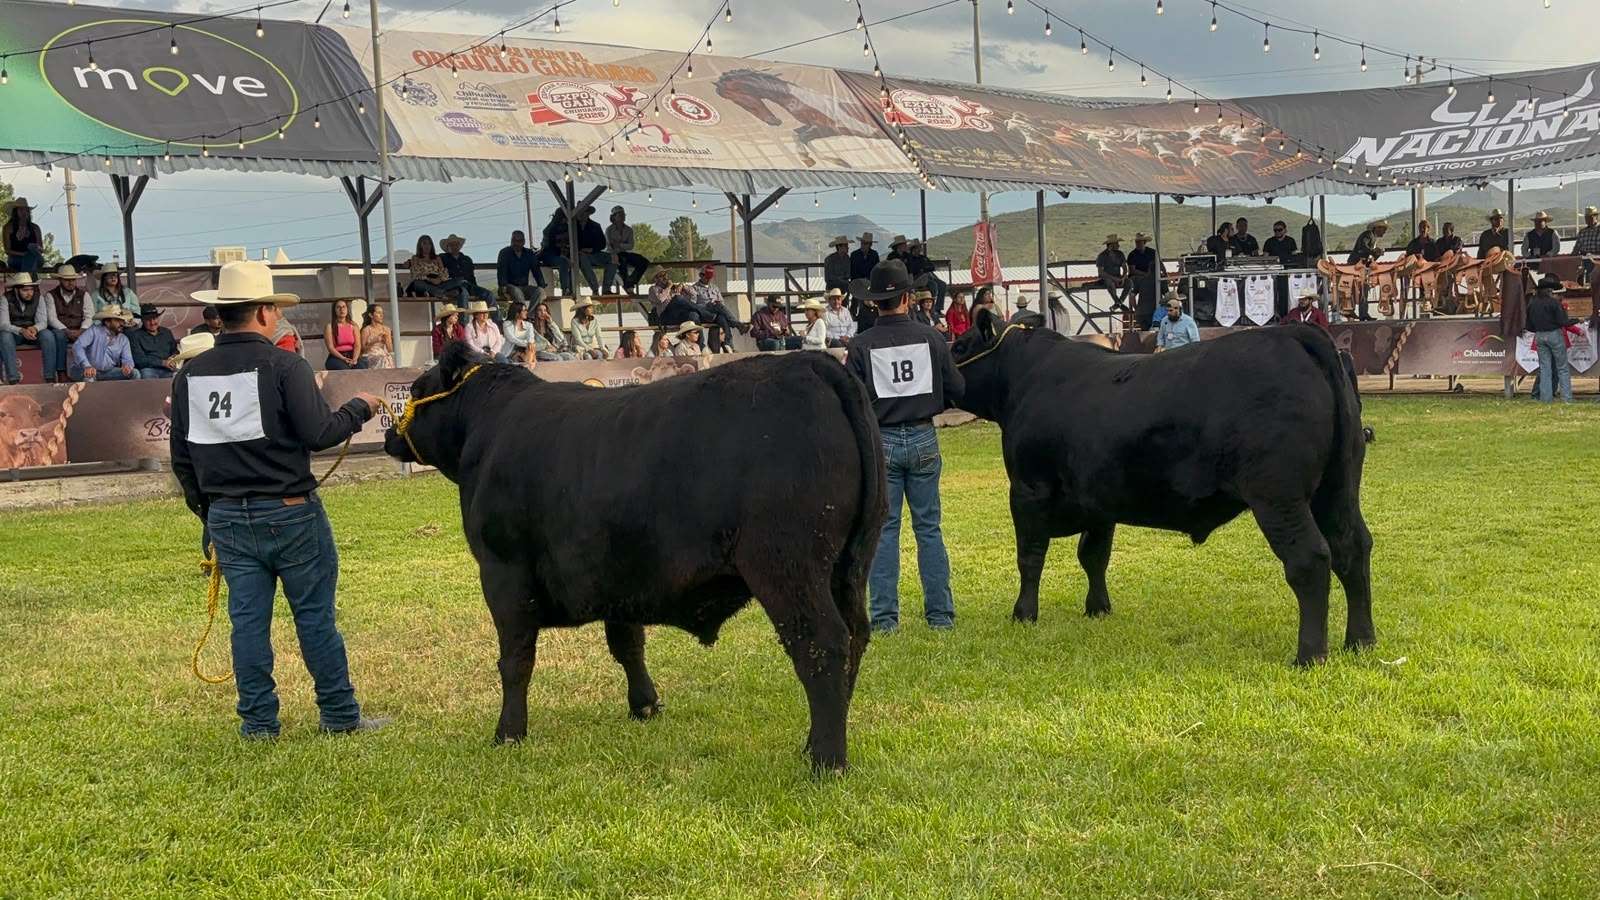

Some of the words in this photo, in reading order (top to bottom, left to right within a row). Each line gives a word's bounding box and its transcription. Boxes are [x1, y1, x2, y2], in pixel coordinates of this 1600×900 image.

[411, 49, 530, 74] ORGULLO
[72, 65, 268, 97] move
[550, 91, 591, 103] EXPO
[561, 98, 595, 109] GAN
[902, 100, 938, 109] EXPO
[563, 106, 607, 114] CHIHUAHUA
[1335, 109, 1600, 166] NACIONA
[1389, 160, 1477, 176] PRESTIGIO
[1481, 156, 1505, 166] EN
[1505, 145, 1568, 160] CARNE
[1463, 349, 1506, 358] Chihuahua!
[890, 360, 914, 384] 18
[608, 377, 640, 386] BUFFALO
[208, 391, 232, 419] 24
